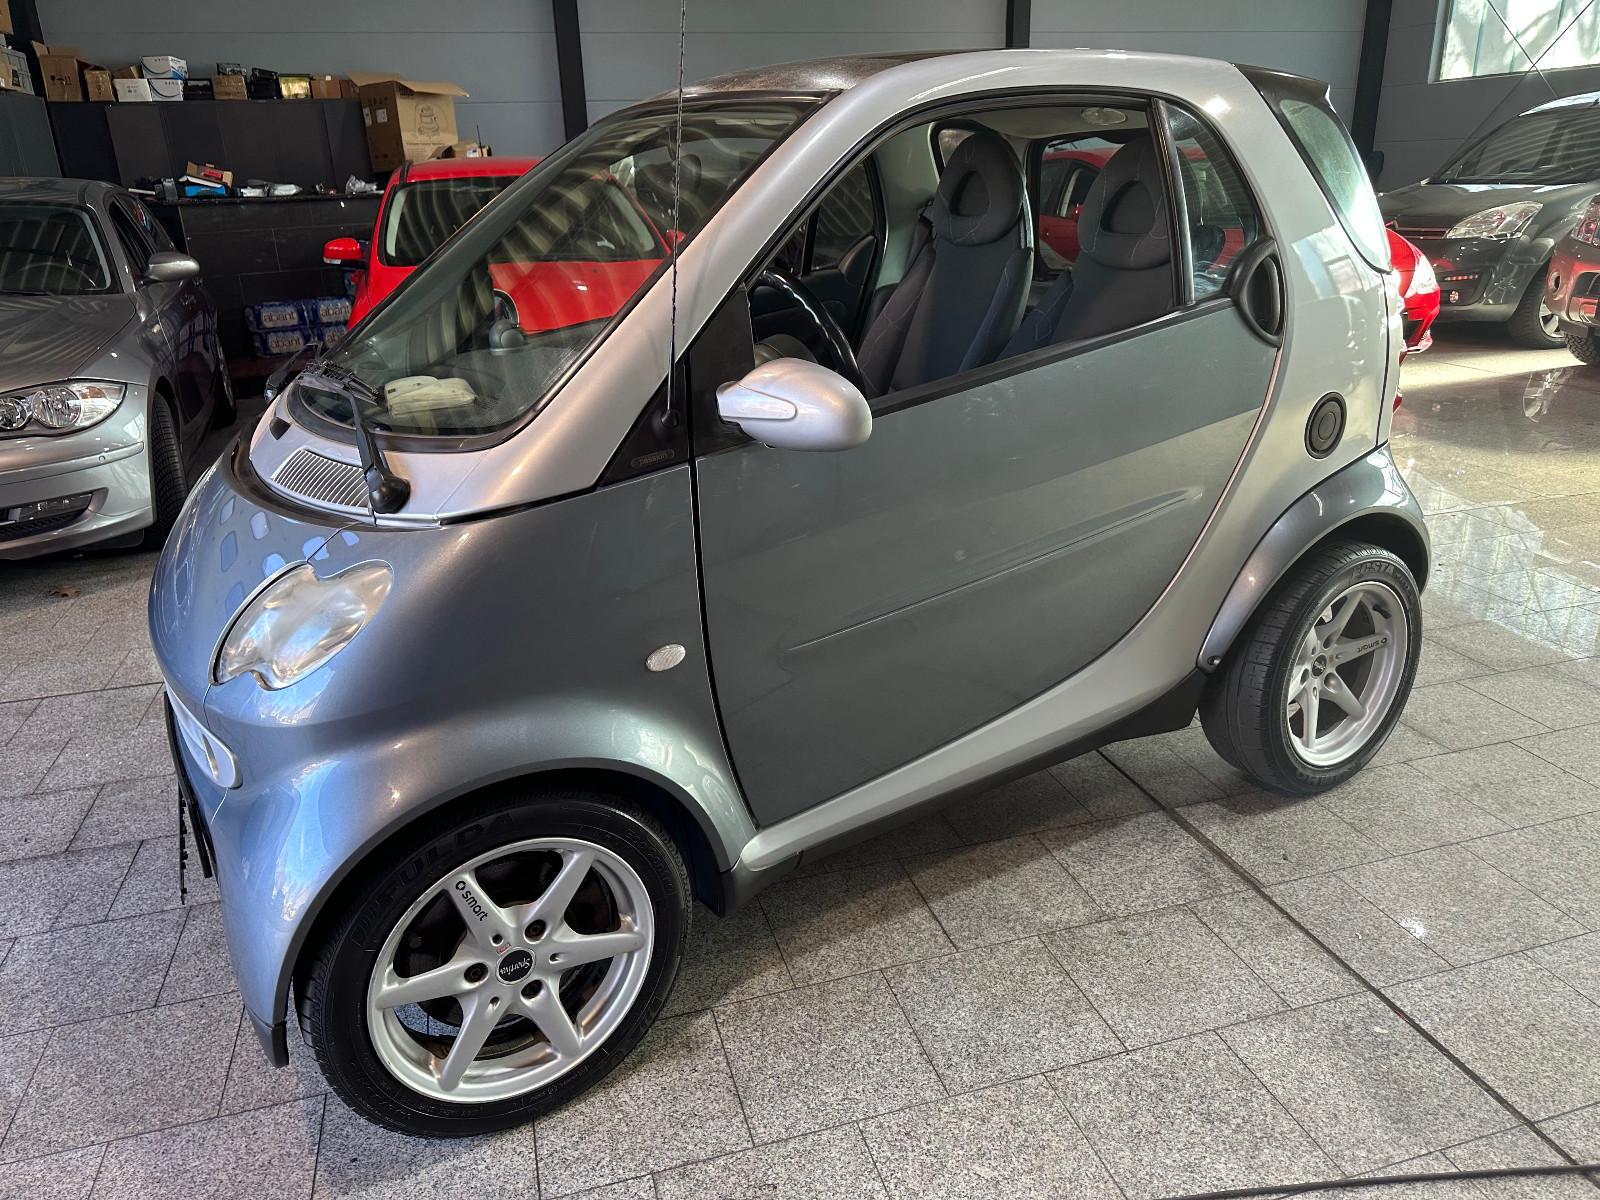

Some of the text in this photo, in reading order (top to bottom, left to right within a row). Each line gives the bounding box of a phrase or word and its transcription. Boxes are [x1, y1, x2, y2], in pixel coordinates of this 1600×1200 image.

[263, 311, 296, 322] abant
[270, 337, 301, 349] abant
[1357, 640, 1379, 653] smart
[461, 890, 488, 922] smart
